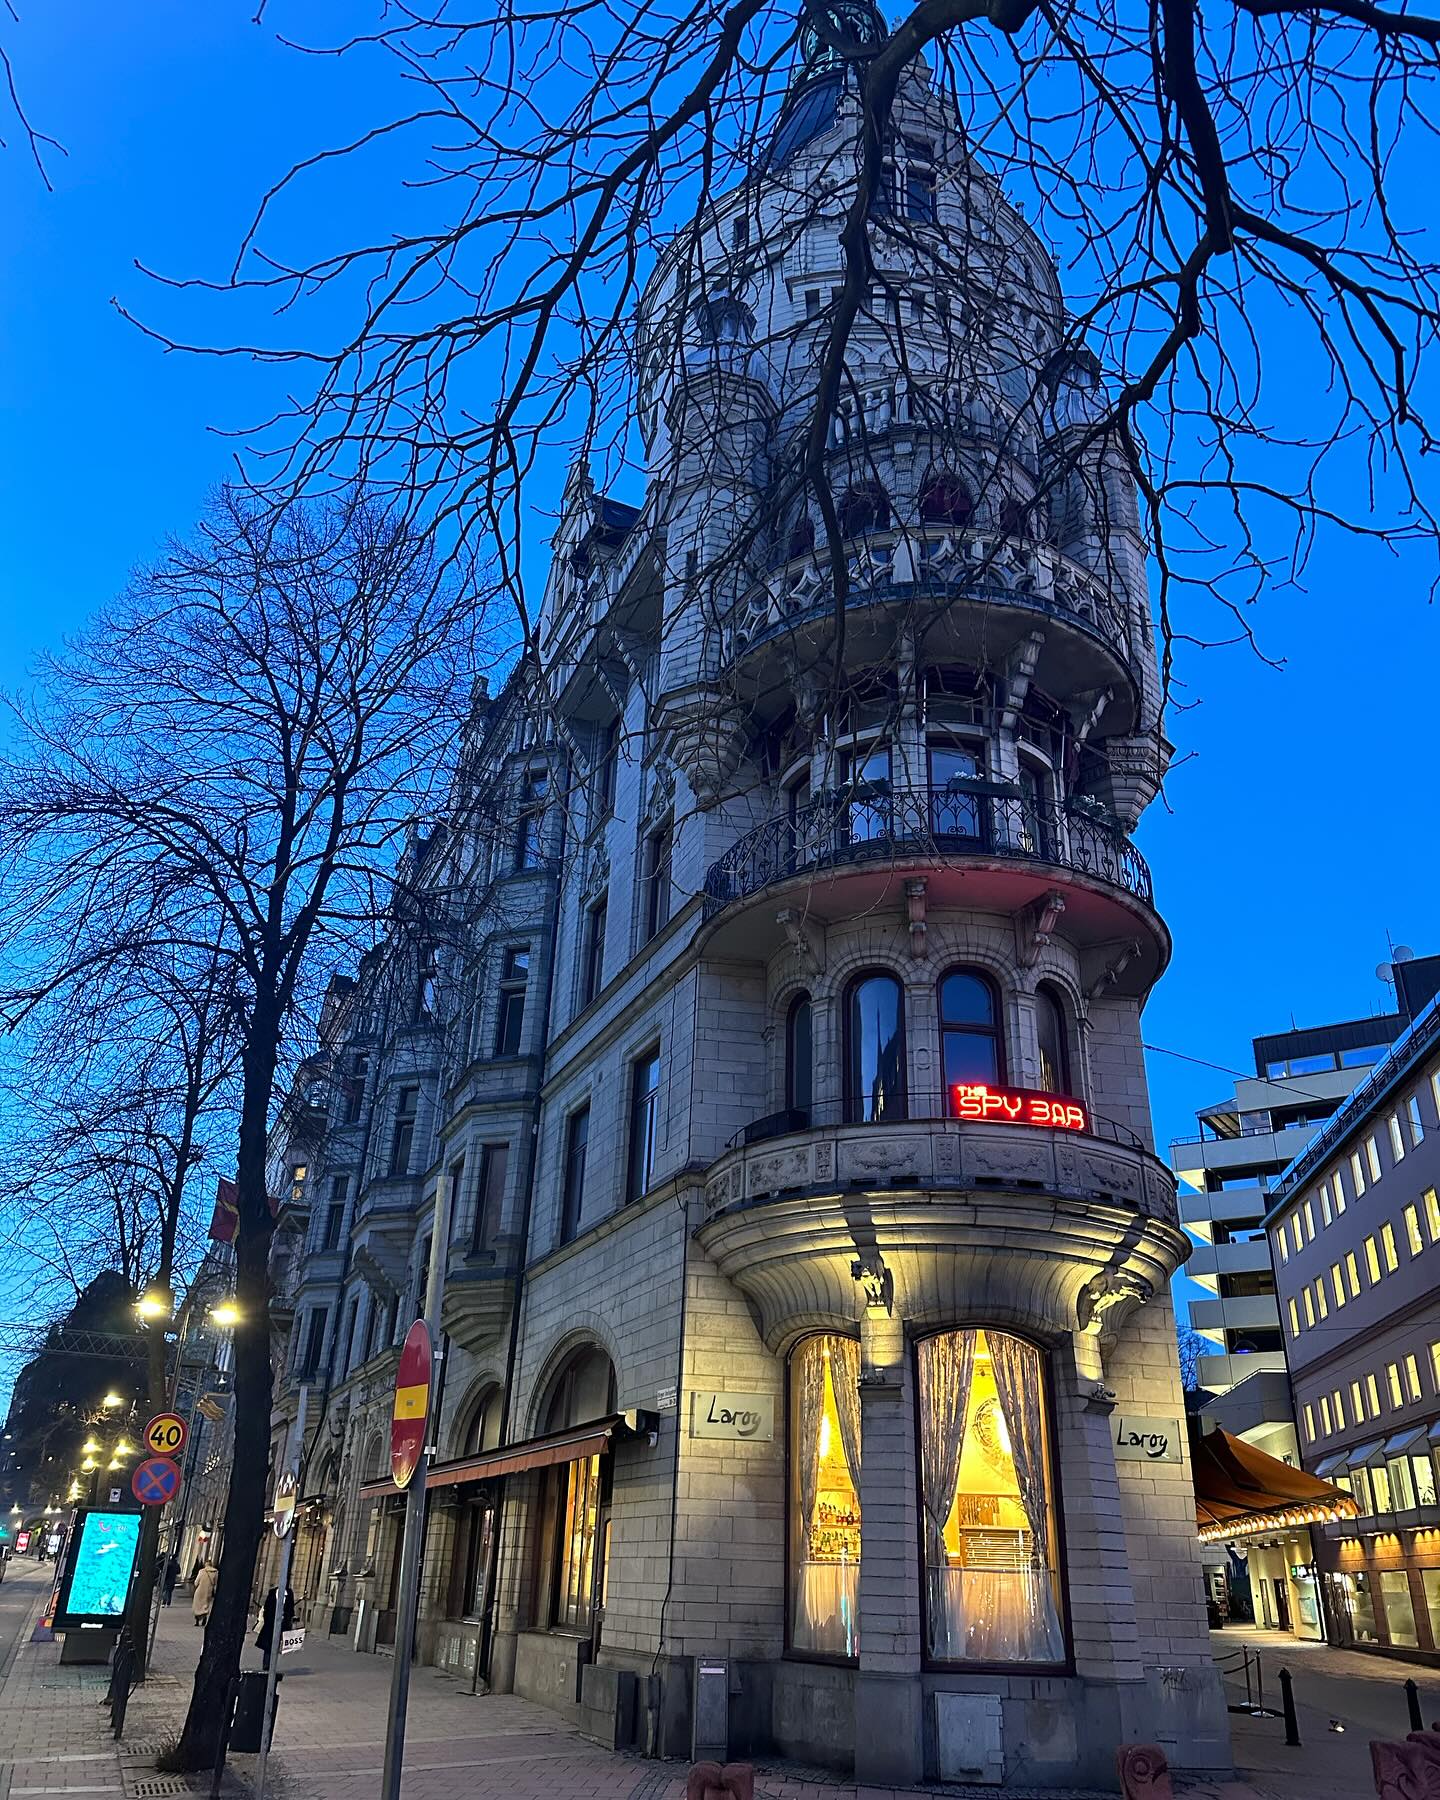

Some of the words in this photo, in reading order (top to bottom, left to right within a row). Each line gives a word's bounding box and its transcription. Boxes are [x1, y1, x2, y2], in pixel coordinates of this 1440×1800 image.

[958, 1086, 987, 1096] THE
[960, 1096, 1022, 1117] SPY
[1030, 1100, 1084, 1128] BAR
[707, 1395, 761, 1436] Laroy
[150, 1425, 180, 1446] 40
[1117, 1418, 1168, 1458] Laroy
[285, 1637, 302, 1646] BOSS
